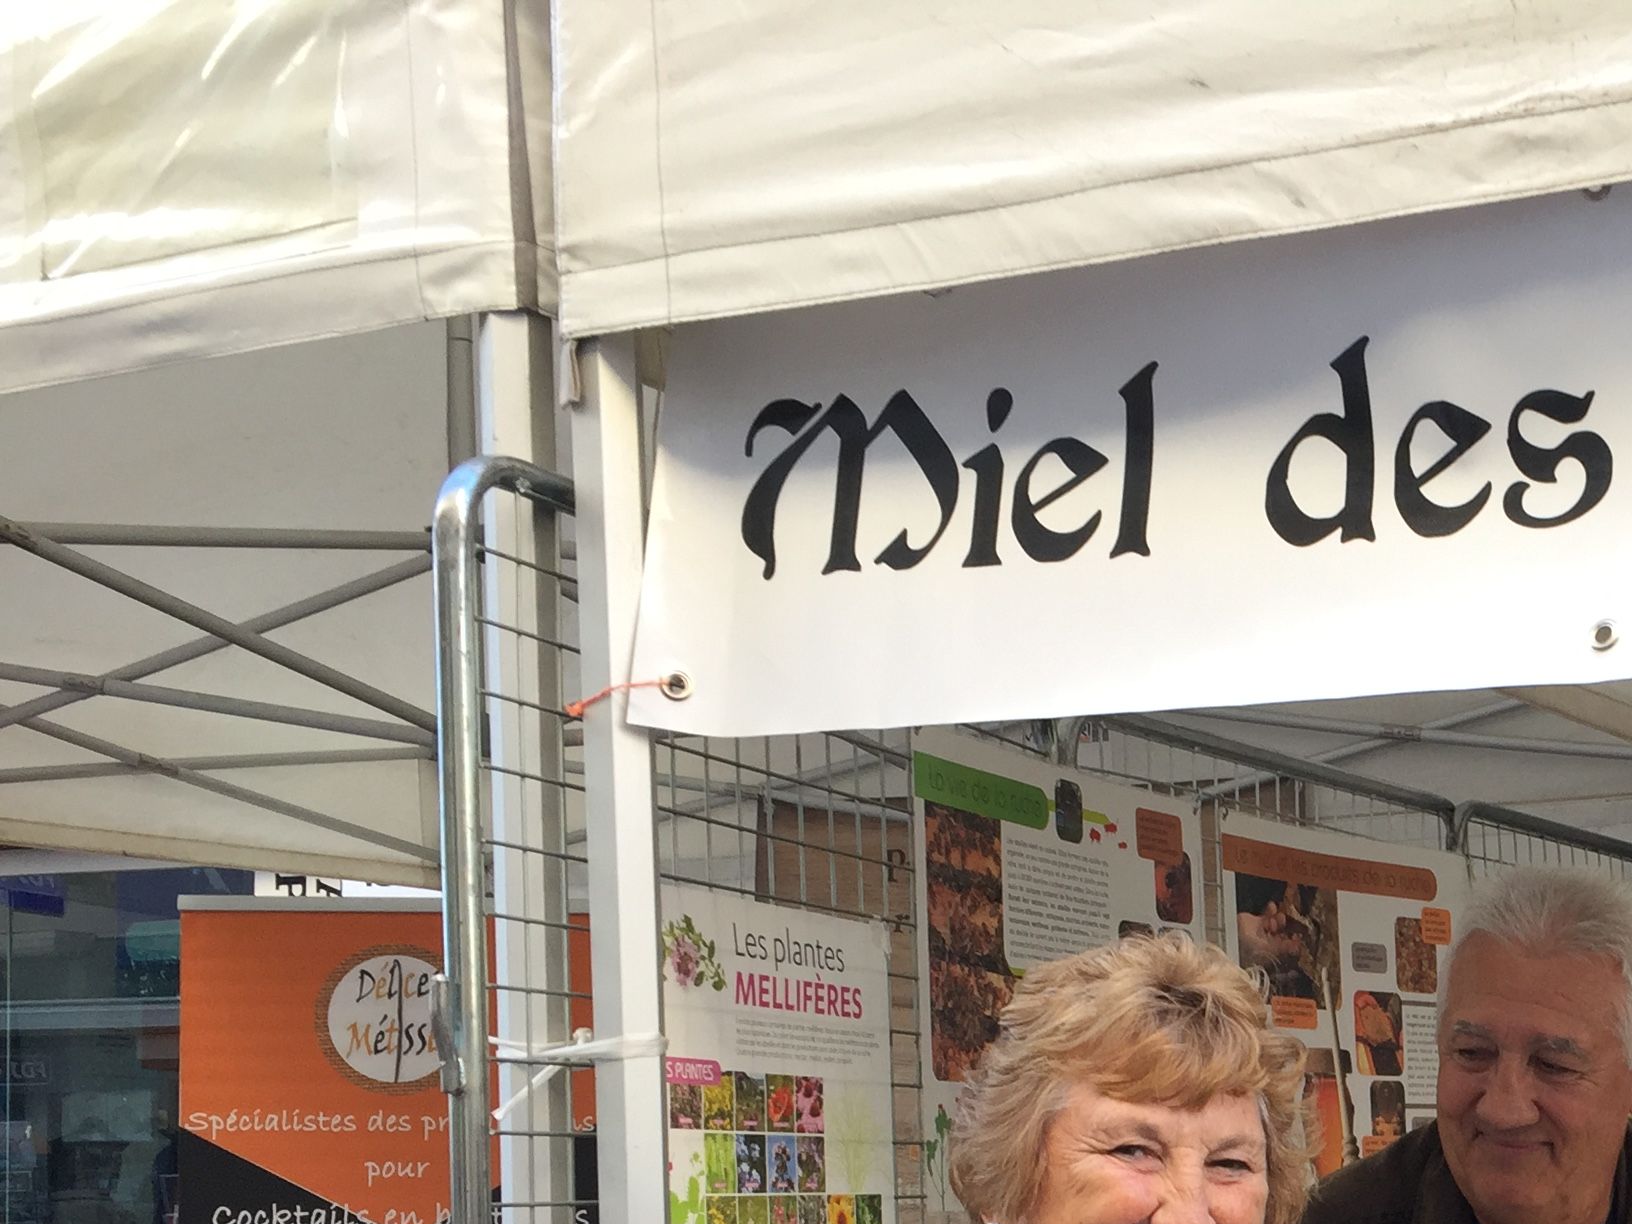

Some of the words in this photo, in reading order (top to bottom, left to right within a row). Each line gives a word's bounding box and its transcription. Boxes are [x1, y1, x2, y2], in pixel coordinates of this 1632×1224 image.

[741, 360, 1159, 581] Miel
[1265, 335, 1614, 547] des
[732, 922, 768, 961] Les
[774, 927, 846, 973] plantes
[356, 959, 440, 1002] Délice
[735, 971, 863, 1020] MELLIFÈRES
[675, 1063, 714, 1081] PLANTES
[184, 1108, 358, 1140] Spécialistes
[367, 1109, 412, 1132] des
[365, 1159, 431, 1187] pour
